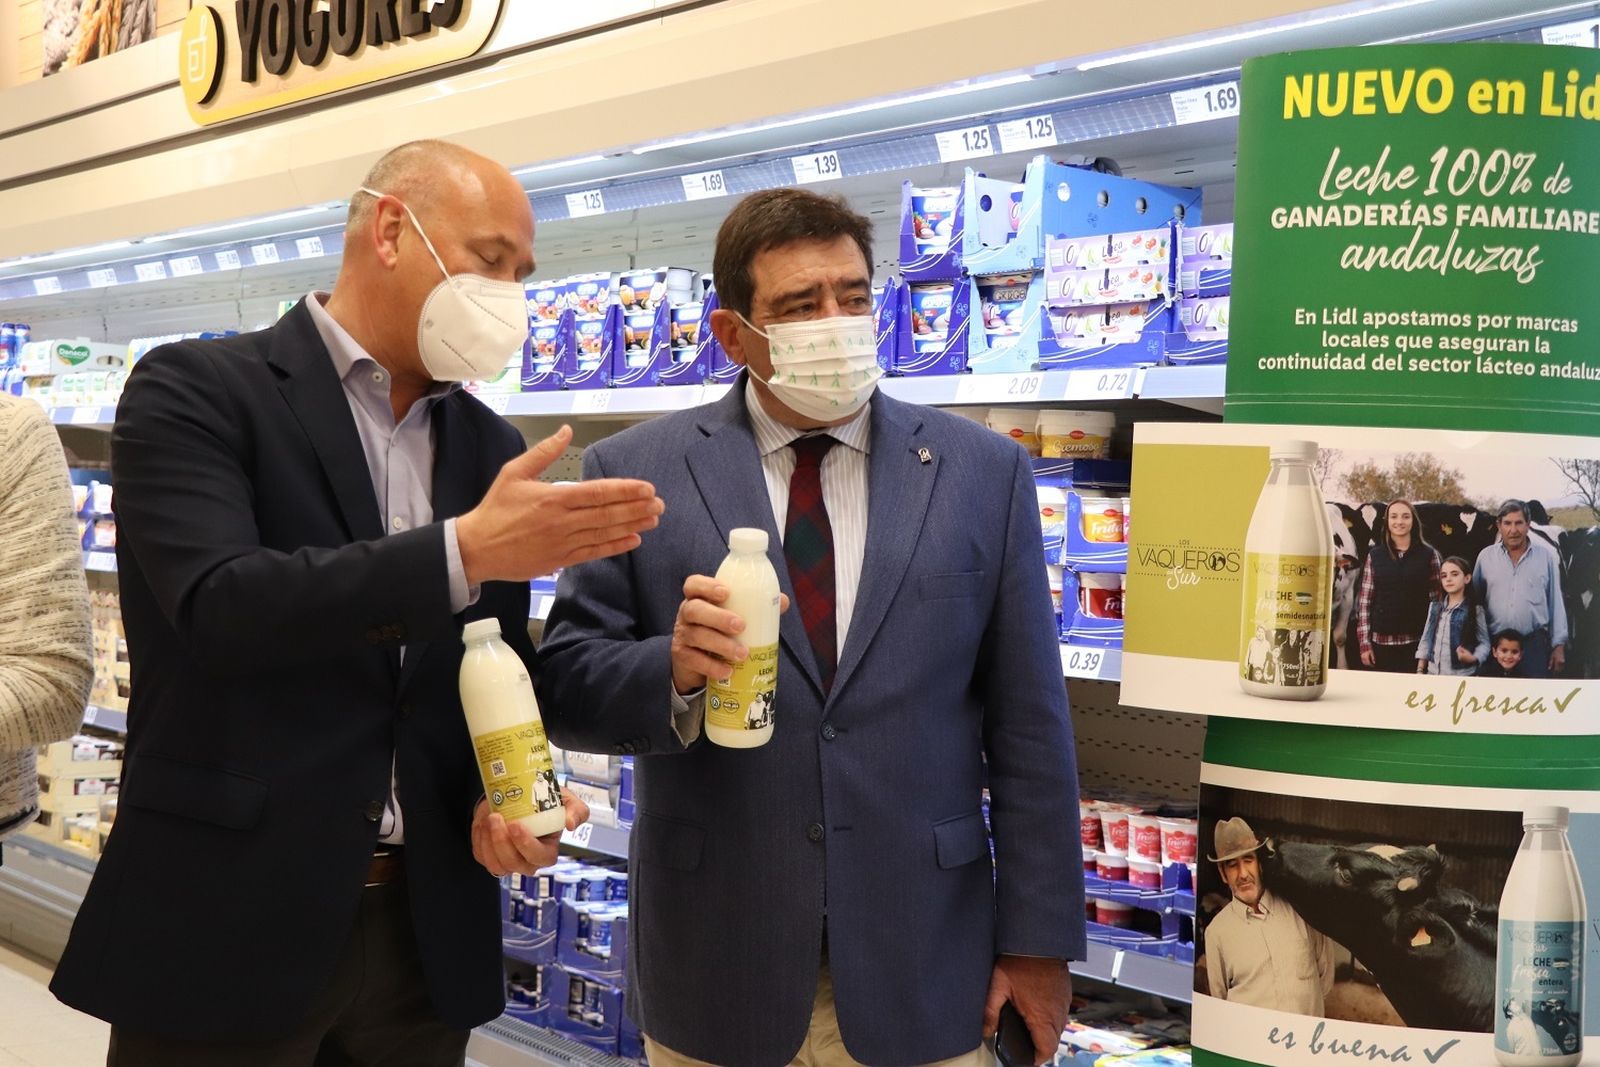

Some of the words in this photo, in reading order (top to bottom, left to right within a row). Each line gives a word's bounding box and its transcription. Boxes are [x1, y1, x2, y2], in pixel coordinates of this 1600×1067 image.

[1204, 87, 1237, 112] 1.69
[1283, 69, 1454, 120] NUEVO
[1467, 79, 1526, 116] en
[962, 129, 989, 151] 1.25
[1026, 117, 1053, 140] 1.25
[814, 154, 838, 175] 1.39
[1318, 145, 1419, 201] Leche
[1423, 146, 1537, 197] 100%
[1543, 162, 1573, 195] de
[702, 173, 722, 192] 1.69
[583, 193, 601, 210] 1.25
[1271, 201, 1448, 229] GANADERÍAS
[1455, 204, 1600, 235] FAMILIARE
[1340, 225, 1544, 284] andaluzas
[1295, 308, 1317, 326] En
[1322, 307, 1357, 326] Lidl
[1362, 309, 1472, 333] apostamos
[1477, 313, 1510, 332] por
[1517, 315, 1579, 333] marcas
[1322, 331, 1390, 349] locales
[1395, 334, 1433, 352] que
[1438, 335, 1530, 355] aseguran
[1535, 336, 1551, 354] la
[1258, 353, 1366, 371] continuidad
[1371, 353, 1402, 371] del
[1408, 357, 1473, 373] sector
[1476, 356, 1536, 376] lácteo
[1540, 361, 1600, 381] andaluz
[1008, 376, 1039, 395] 2.09
[1097, 373, 1128, 392] 0.72
[1136, 547, 1241, 573] VAQUEROS
[1166, 565, 1201, 590] Sur
[1069, 651, 1101, 671] 0.39
[1404, 690, 1438, 713] es
[1450, 680, 1548, 726] fresca
[1267, 1026, 1297, 1050] es
[1308, 1021, 1412, 1063] buena
